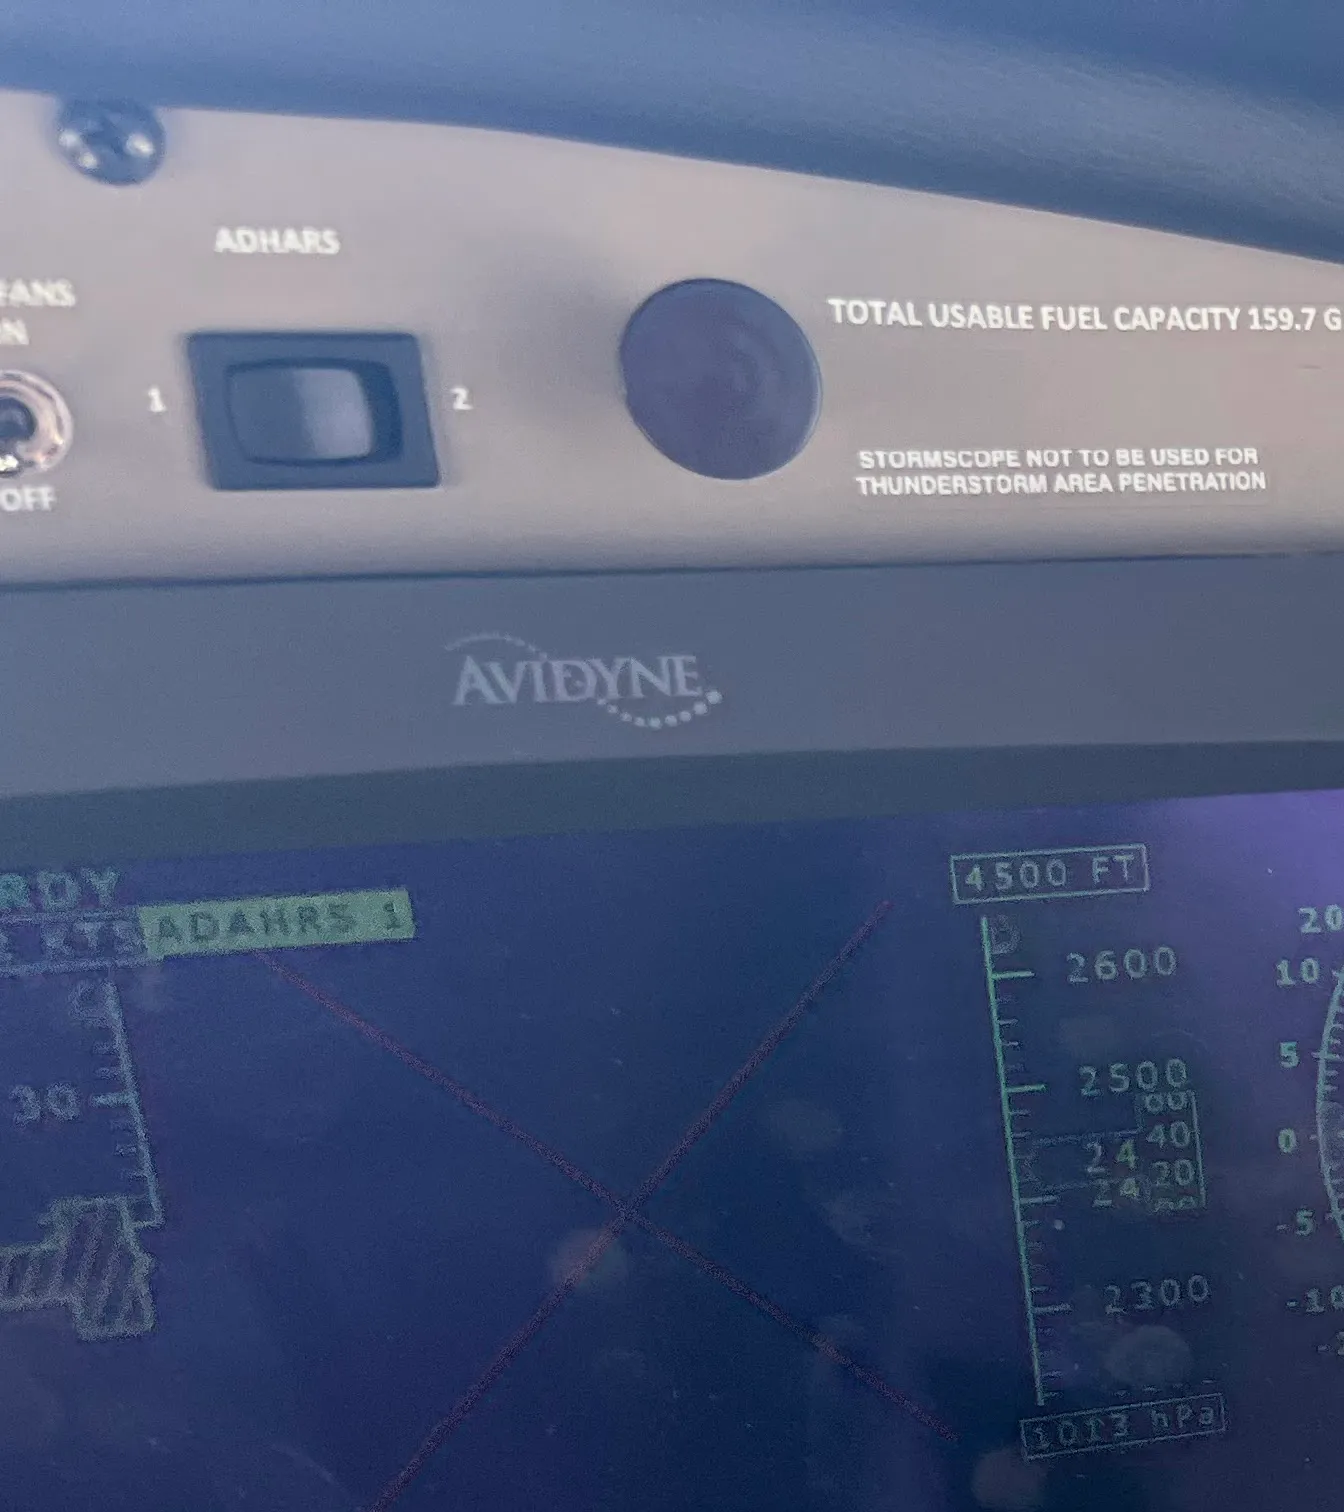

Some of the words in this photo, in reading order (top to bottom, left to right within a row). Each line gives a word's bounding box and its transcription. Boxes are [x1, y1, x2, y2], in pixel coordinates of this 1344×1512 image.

[215, 228, 340, 254] ADHARS
[828, 299, 922, 327] TOTAL
[929, 303, 1034, 330] USABLE
[1042, 305, 1107, 330] FUEL
[1114, 307, 1240, 331] CAPACITY
[1250, 307, 1315, 331] 159.7
[148, 388, 166, 412] 1
[450, 388, 472, 410] 2
[859, 450, 1019, 469] STORMSCOPE
[1026, 450, 1072, 468] NOT
[1079, 450, 1109, 467] TO
[1116, 449, 1144, 467] BE
[1151, 449, 1209, 467] USED
[1216, 448, 1257, 466] FOR
[856, 476, 1048, 495] THUNDERSTORM
[1055, 474, 1112, 493] AREA
[1119, 471, 1265, 492] PENETRATION
[0, 487, 55, 511] OFF
[453, 655, 702, 705] AVIDYNE
[963, 857, 1069, 891] 4500
[1091, 853, 1136, 882] FT
[156, 903, 357, 947] ADAHRS
[1299, 905, 1344, 934] 20
[1066, 946, 1179, 984] 2600
[1276, 958, 1320, 986] 10
[1280, 1042, 1300, 1067] 5
[1078, 1058, 1190, 1098] 2500
[1277, 1128, 1297, 1153] 0
[1106, 1273, 1210, 1315] 2300
[1030, 1411, 1128, 1449] 1013
